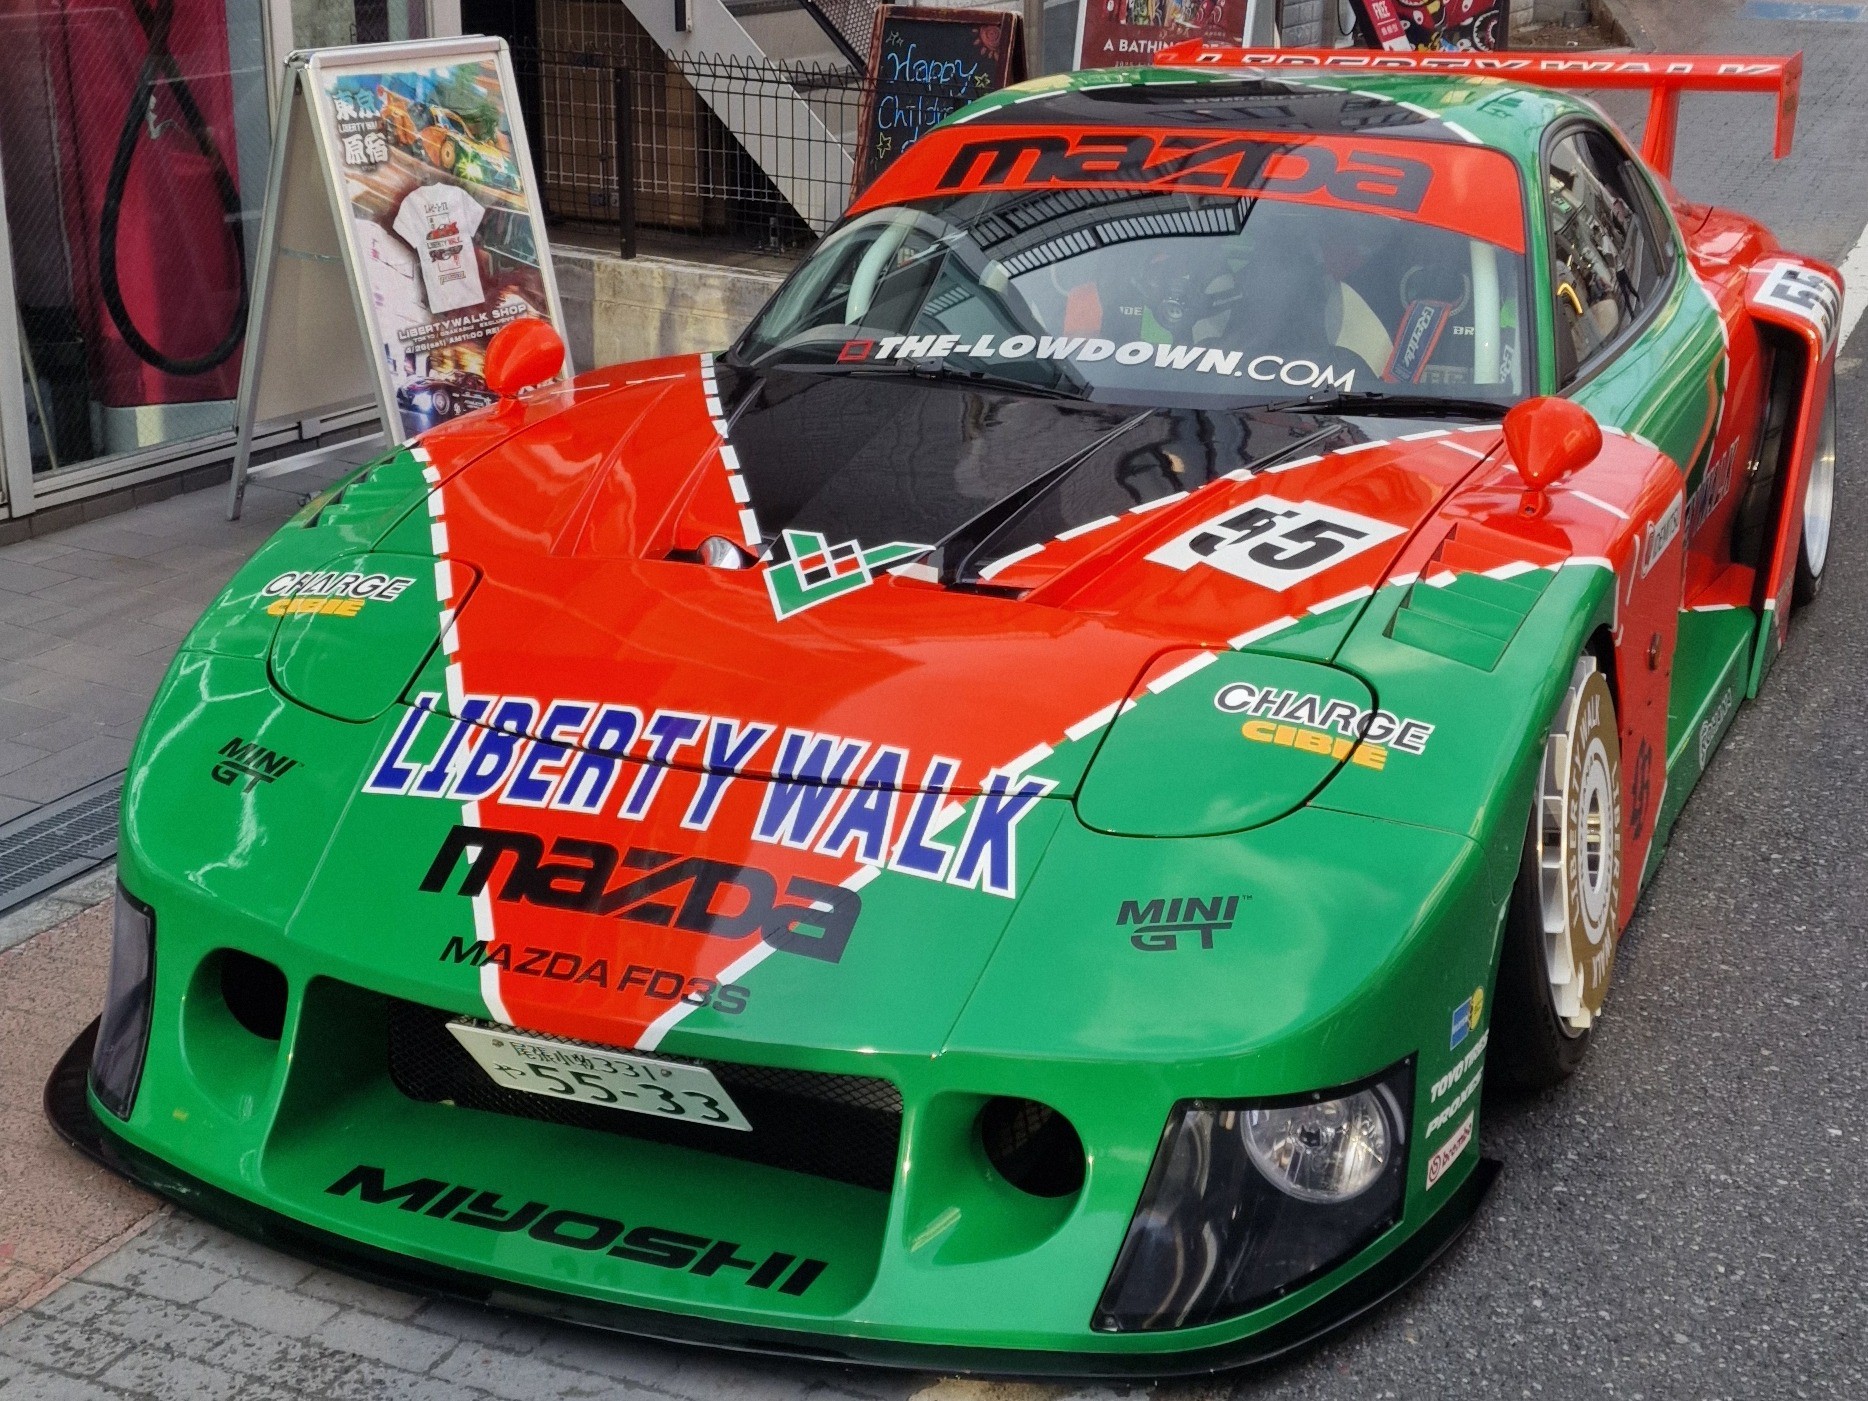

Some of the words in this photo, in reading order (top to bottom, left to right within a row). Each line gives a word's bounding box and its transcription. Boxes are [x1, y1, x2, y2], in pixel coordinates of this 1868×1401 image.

[1103, 38, 1114, 51] A
[887, 43, 978, 96] Happy
[333, 88, 380, 120] 東京
[342, 132, 388, 164] 原宿
[398, 312, 489, 340] LIBERTYWALK
[491, 304, 527, 319] SHOP
[262, 571, 417, 602] CHARGE
[1213, 682, 1436, 755] CHARGE
[218, 737, 299, 778] MINI
[1241, 720, 1389, 771] CIBIE
[210, 760, 277, 794] GT
[361, 691, 770, 833] LIBERTY
[751, 730, 1061, 899] WALK
[1115, 895, 1240, 926] MINI
[1130, 922, 1233, 952] GT
[439, 936, 609, 988] MAZDA
[616, 964, 751, 1015] FD3S
[525, 1062, 730, 1123] 55-33
[323, 1164, 829, 1297] MIYOSHI
